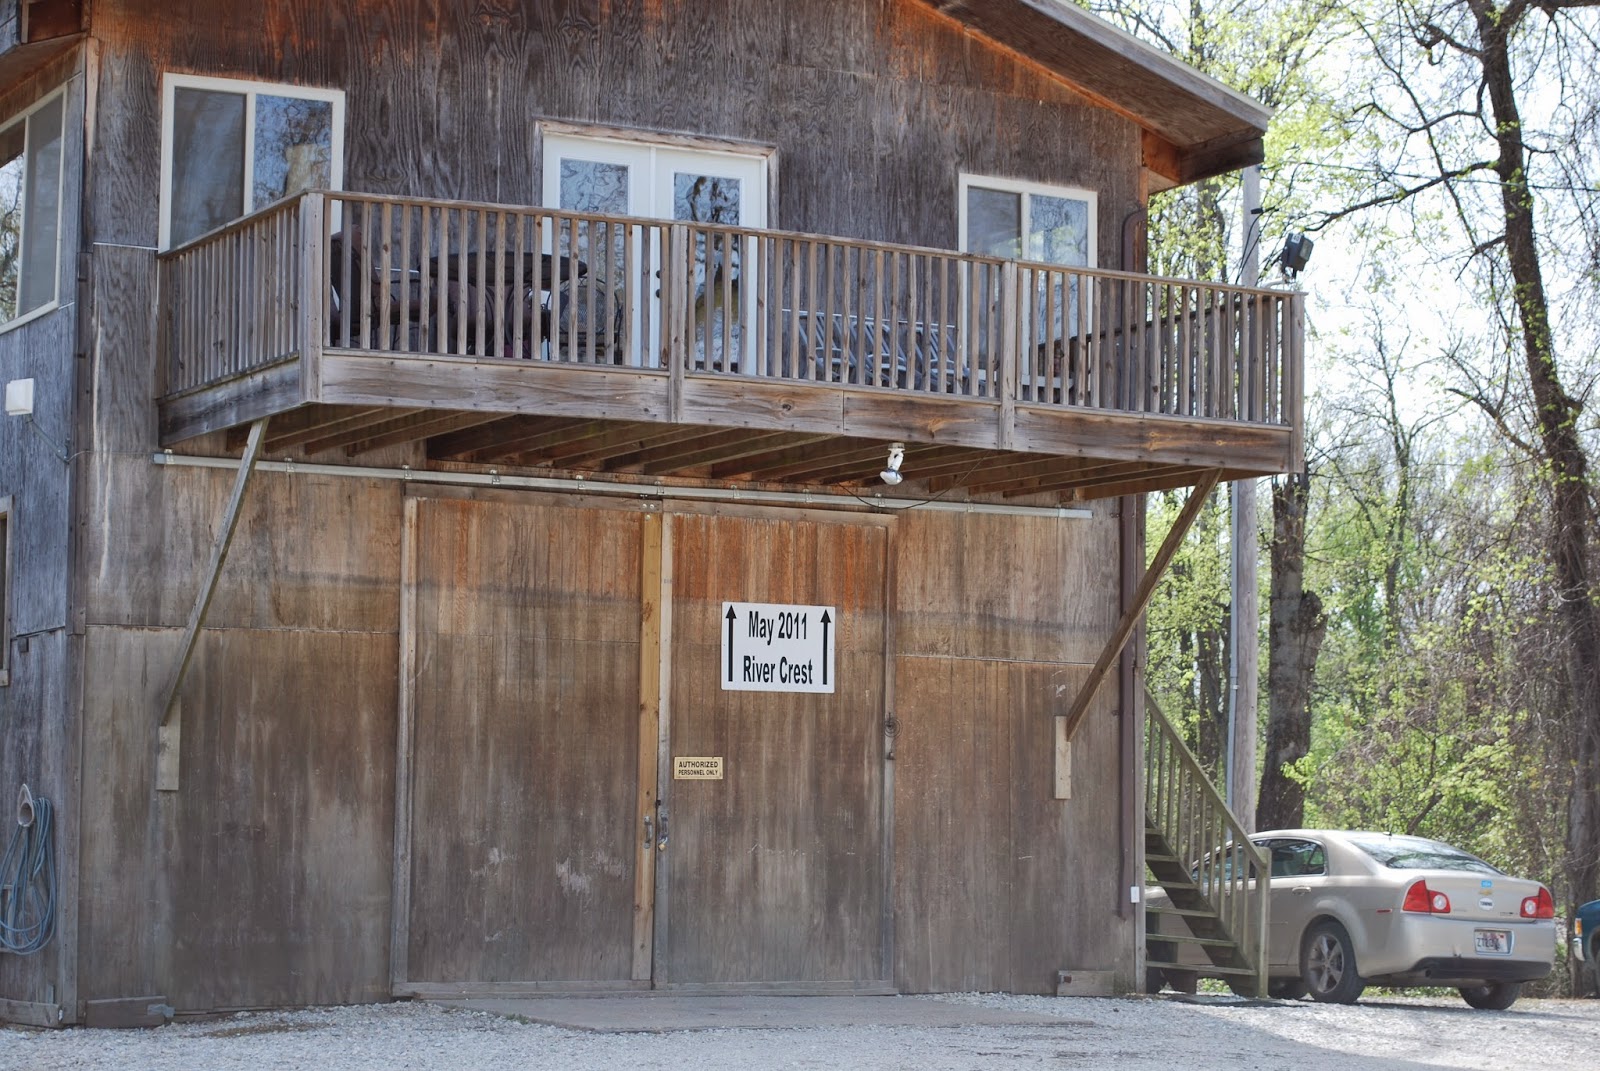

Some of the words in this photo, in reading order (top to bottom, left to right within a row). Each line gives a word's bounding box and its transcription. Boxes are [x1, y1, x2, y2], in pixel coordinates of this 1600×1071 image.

[748, 610, 774, 646] May
[778, 611, 807, 640] 2011
[743, 655, 776, 683] River
[779, 656, 813, 684] Crest
